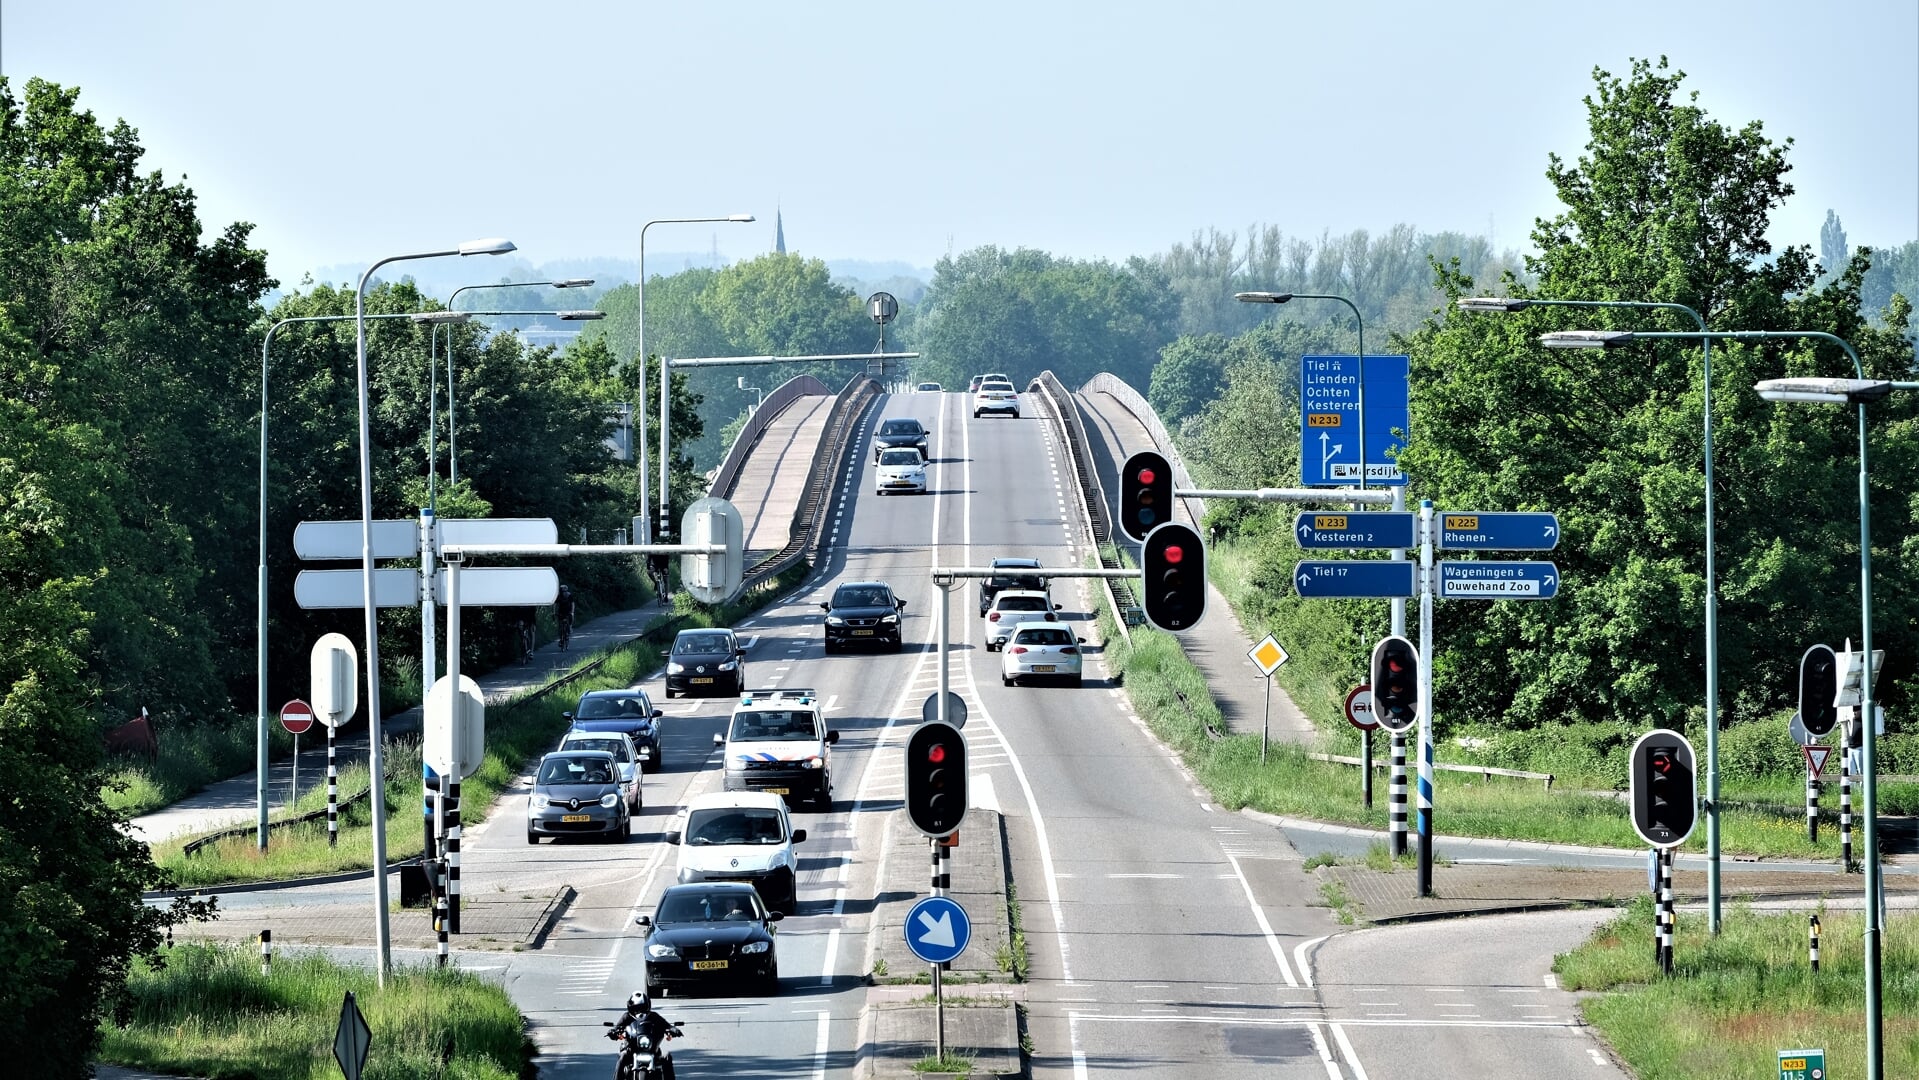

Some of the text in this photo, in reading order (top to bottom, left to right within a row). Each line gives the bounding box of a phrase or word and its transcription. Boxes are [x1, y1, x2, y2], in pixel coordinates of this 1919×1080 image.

[1306, 361, 1329, 371] Tiel
[1307, 374, 1356, 384] Lienden
[1307, 387, 1350, 397] Ochten
[1349, 466, 1399, 478] Mrsdijk
[1314, 532, 1364, 541] Kesteren
[1445, 532, 1486, 542] Rhenen
[1313, 567, 1348, 576] Tiel 17
[1444, 567, 1524, 578] Wageningen 6
[1447, 581, 1531, 591] Ouwehand Zoo
[1783, 1060, 1804, 1068] N233
